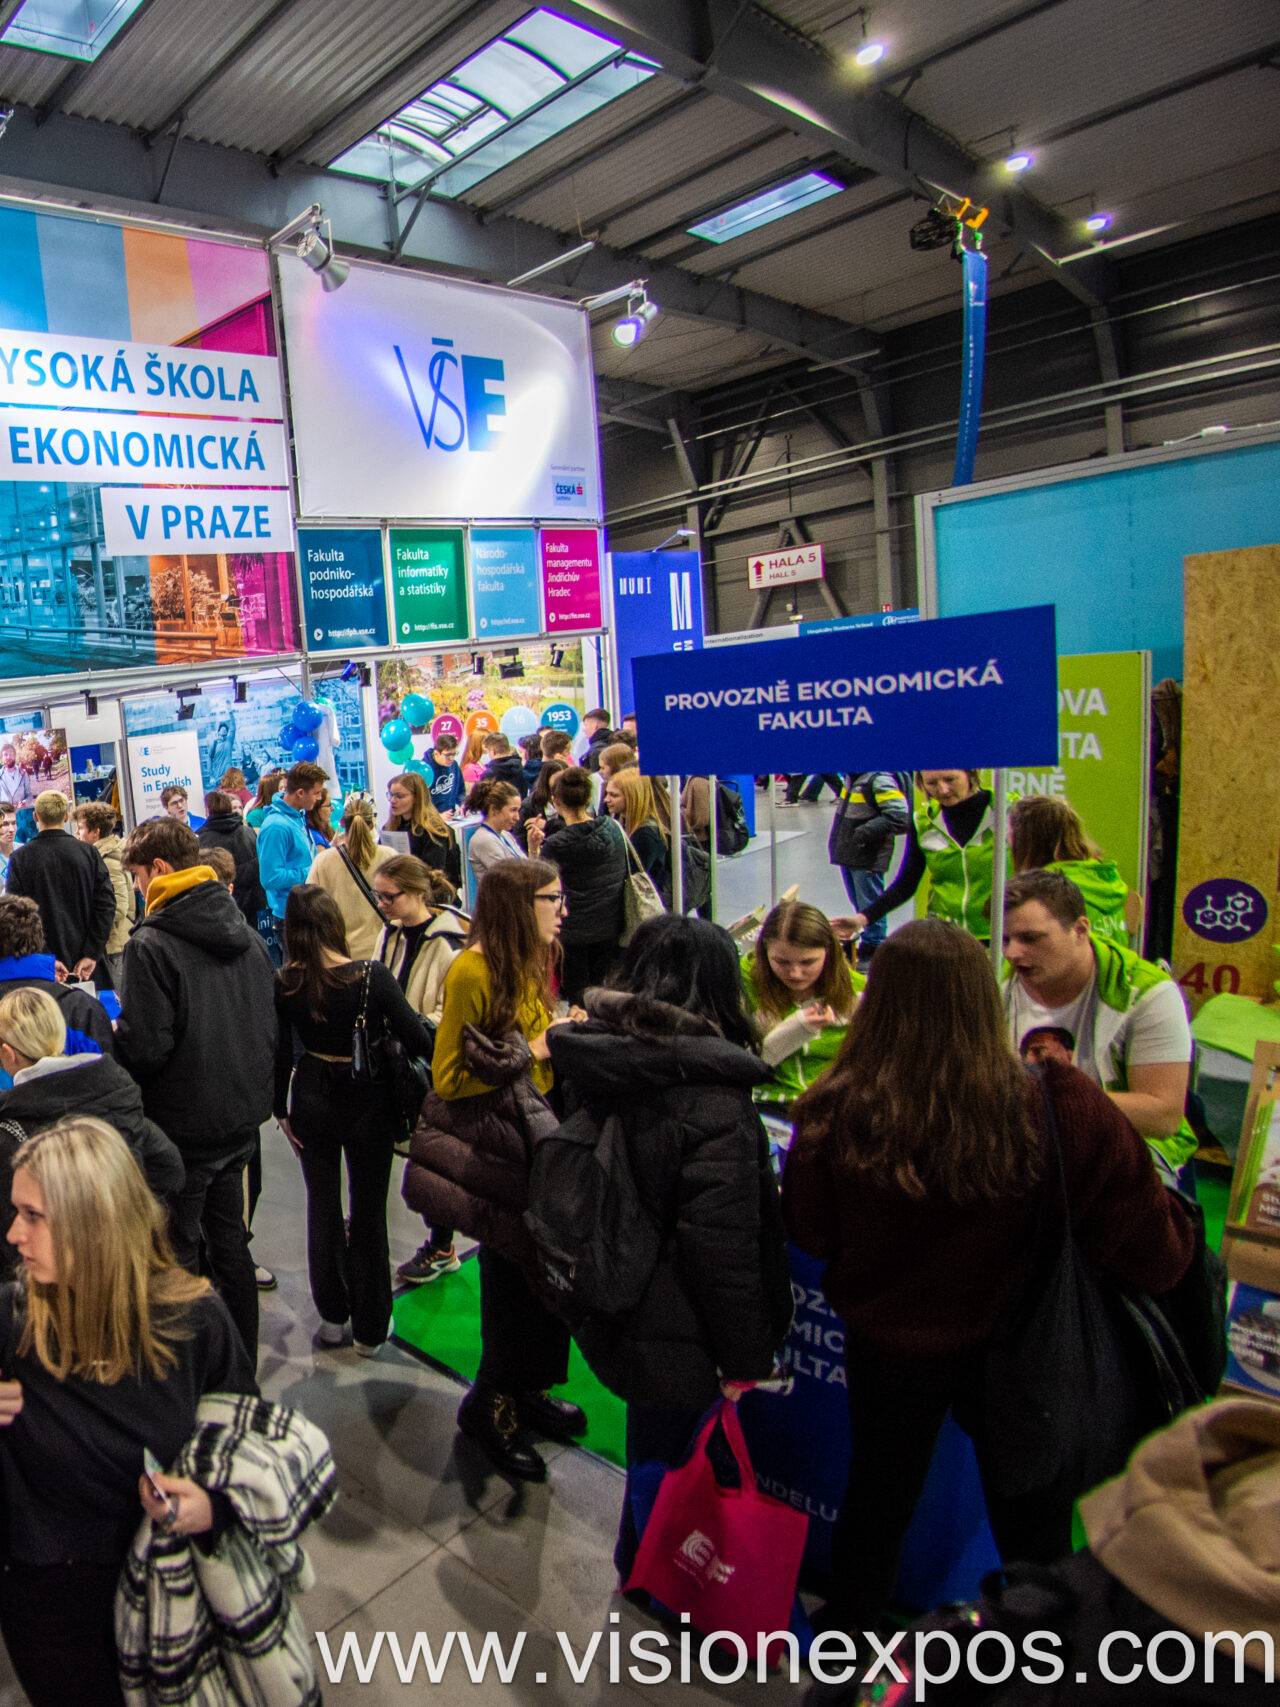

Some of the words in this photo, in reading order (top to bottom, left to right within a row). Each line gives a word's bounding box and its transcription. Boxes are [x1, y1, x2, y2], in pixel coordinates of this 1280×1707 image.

[144, 352, 260, 403] ŠKOLA
[393, 337, 506, 452] VŠE
[8, 426, 266, 471] EKONOMICKÁ
[125, 504, 150, 540] V
[161, 504, 272, 540] PRAZE
[307, 548, 345, 562] Fakulta
[396, 548, 430, 560] Fakulta
[545, 543, 569, 553] Fakulta
[546, 558, 592, 570] managementu
[769, 555, 805, 570] HALA
[808, 552, 816, 563] 5
[309, 567, 355, 583] podniko-
[398, 565, 449, 580] informatiky
[547, 571, 580, 583] Jindřichův
[770, 571, 790, 580] HALL
[310, 583, 374, 601] hospodářská
[399, 588, 405, 596] a
[407, 583, 446, 597] statistiky
[477, 580, 504, 592] fakulta
[547, 587, 571, 597] Hradec
[620, 576, 652, 595] MUNI
[669, 572, 693, 631] M
[664, 680, 789, 711] PROVOZNĚ
[797, 659, 1003, 701] EKONOMICKÁ
[475, 718, 488, 728] 35
[547, 710, 572, 722] 1953
[758, 706, 873, 731] FAKULTA
[440, 721, 452, 731] 27
[141, 764, 171, 778] Study
[143, 782, 153, 793] in
[156, 776, 192, 791] English
[1179, 962, 1241, 995] 40
